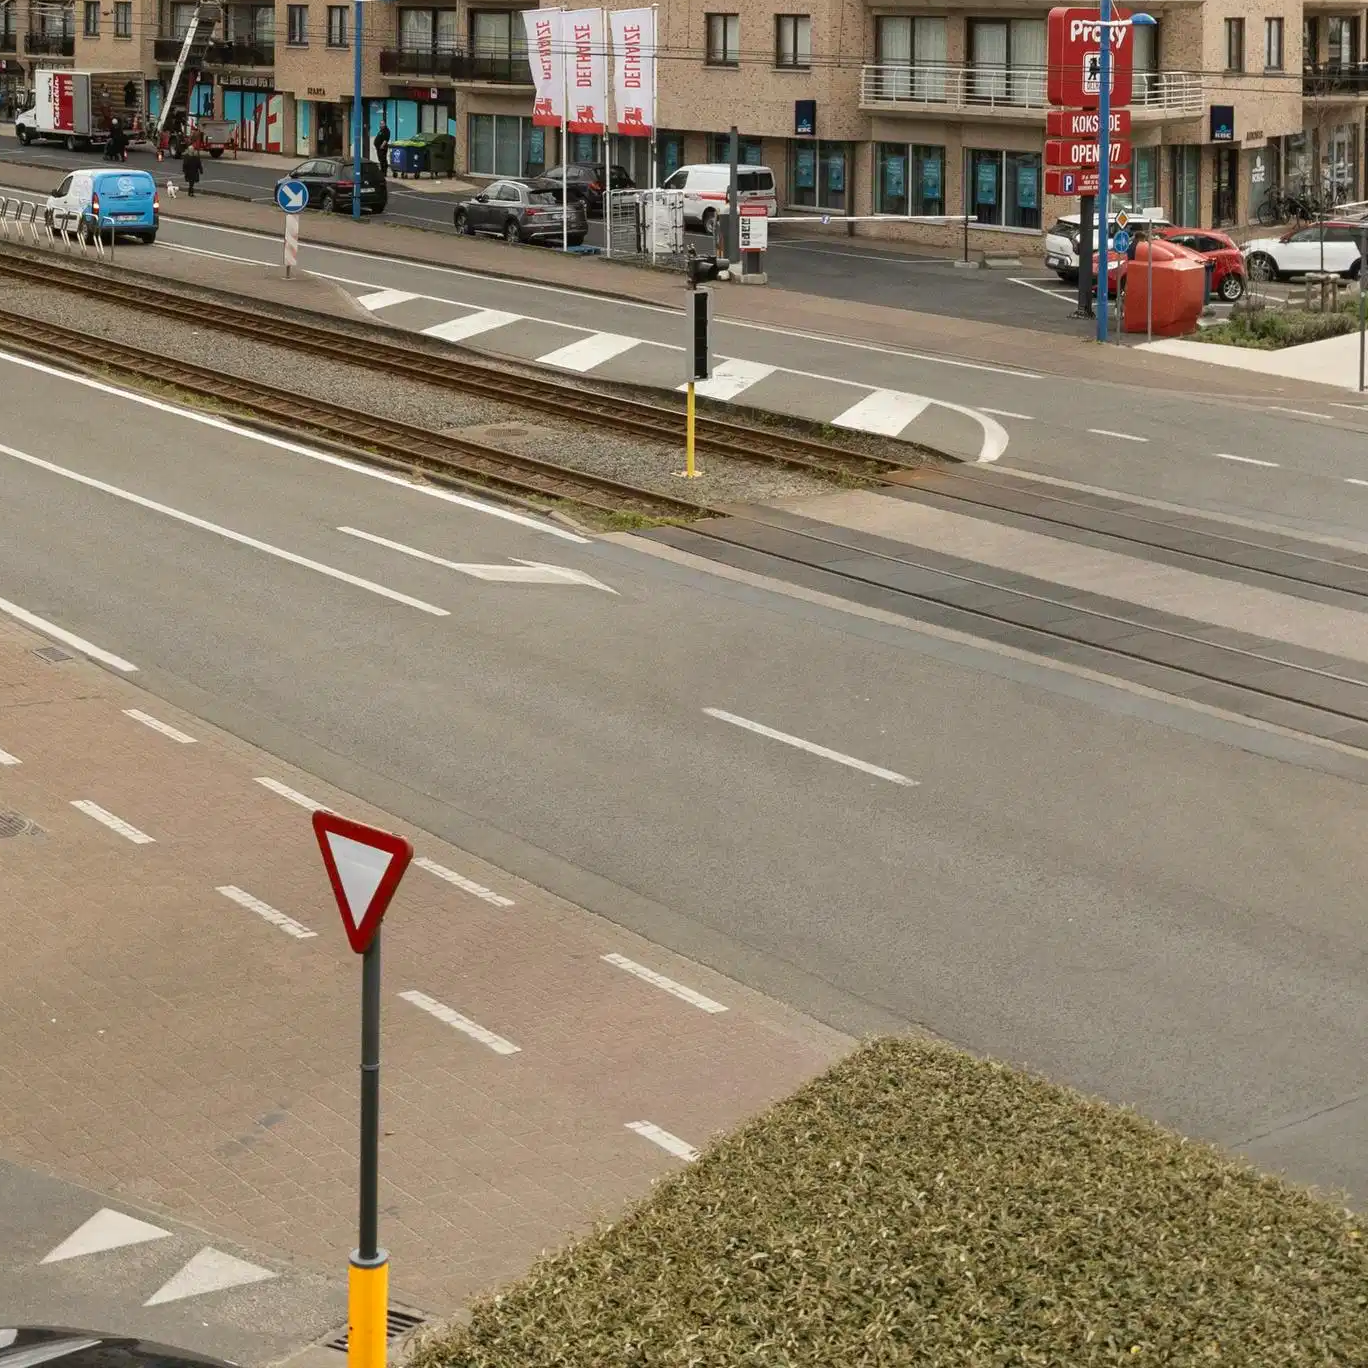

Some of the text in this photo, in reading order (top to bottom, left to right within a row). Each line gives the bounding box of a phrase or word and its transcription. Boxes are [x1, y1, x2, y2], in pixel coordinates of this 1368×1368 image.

[1072, 115, 1121, 133] KOKSDE
[1072, 143, 1121, 162] OPEN /7
[1066, 176, 1072, 191] P
